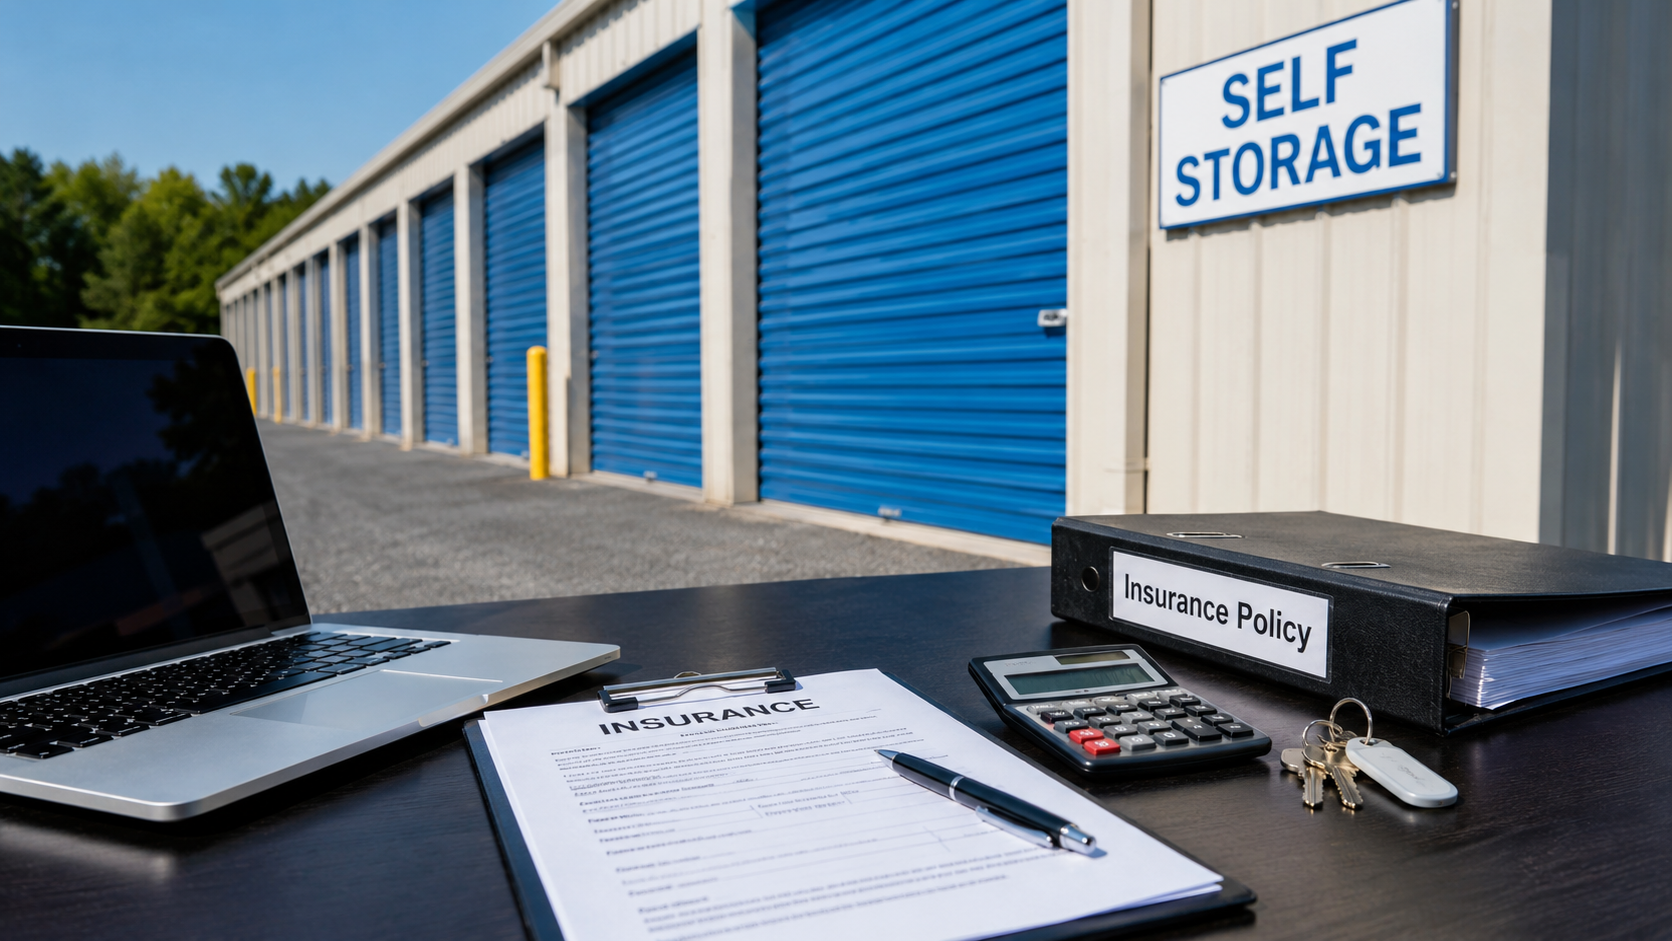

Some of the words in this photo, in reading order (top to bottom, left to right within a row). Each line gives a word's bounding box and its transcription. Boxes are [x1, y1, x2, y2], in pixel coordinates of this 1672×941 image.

[1222, 38, 1357, 128] SELF
[1175, 103, 1421, 207] STORAGE
[1124, 573, 1229, 625] Insurance
[1237, 601, 1312, 653] Policy
[599, 698, 820, 735] INSURANCE
